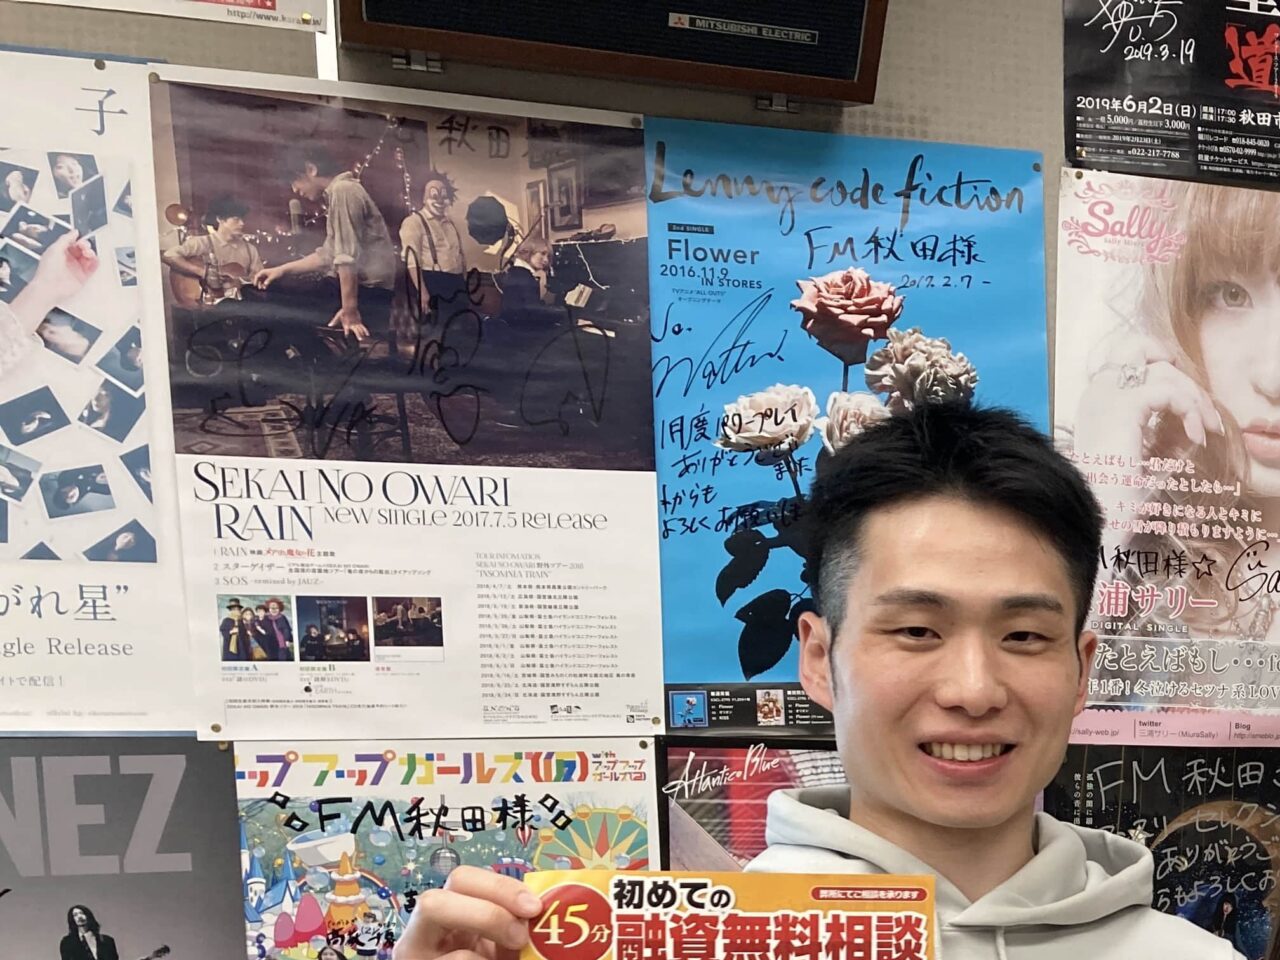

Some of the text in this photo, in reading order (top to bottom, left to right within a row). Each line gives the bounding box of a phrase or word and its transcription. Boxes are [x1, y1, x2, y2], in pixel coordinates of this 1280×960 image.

[695, 18, 813, 42] MITSUBISHI ELECTRIC
[75, 87, 128, 138] 子
[649, 140, 1024, 238] Lenny code fiction
[1080, 200, 1167, 253] Sally
[667, 237, 761, 265] Flower
[660, 263, 729, 281] 2016.11.9
[701, 276, 763, 288] IN STORES
[193, 461, 512, 508] SEKAI NO OWARI
[215, 503, 518, 542] RAIN 2017.7.5
[1090, 621, 1189, 633] DIGITAL SINGLE
[47, 637, 134, 656] Release
[1138, 720, 1162, 728] twitter
[1234, 722, 1251, 731] Blog
[614, 879, 731, 910] 初めての
[533, 899, 613, 949] 45分
